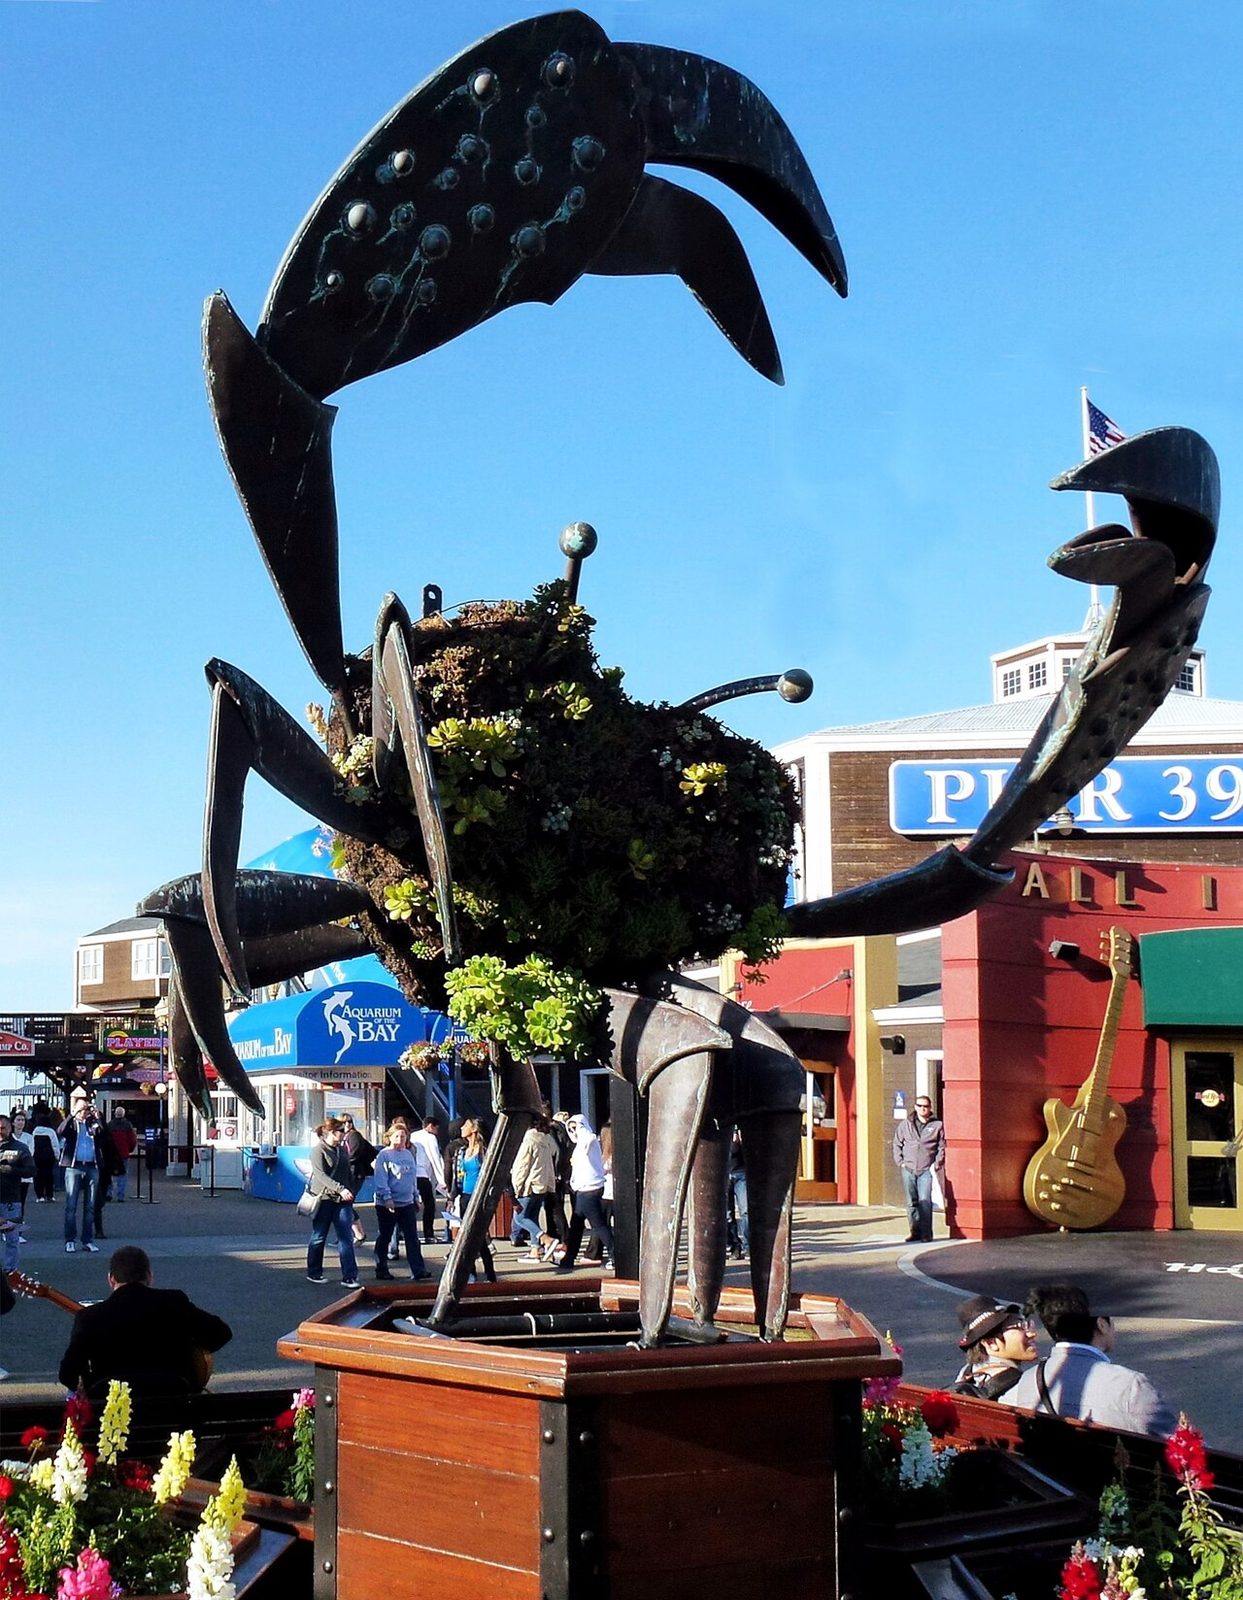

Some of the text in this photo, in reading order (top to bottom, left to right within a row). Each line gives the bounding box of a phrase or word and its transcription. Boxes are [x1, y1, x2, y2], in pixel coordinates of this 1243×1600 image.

[924, 764, 1243, 824] PIR 39
[1022, 862, 1137, 906] ALL
[342, 1005, 402, 1021] AQUARIUM
[275, 1027, 292, 1055] BAY
[358, 1021, 401, 1042] BAY
[14, 1041, 29, 1051] Co.
[320, 1070, 373, 1079] Information
